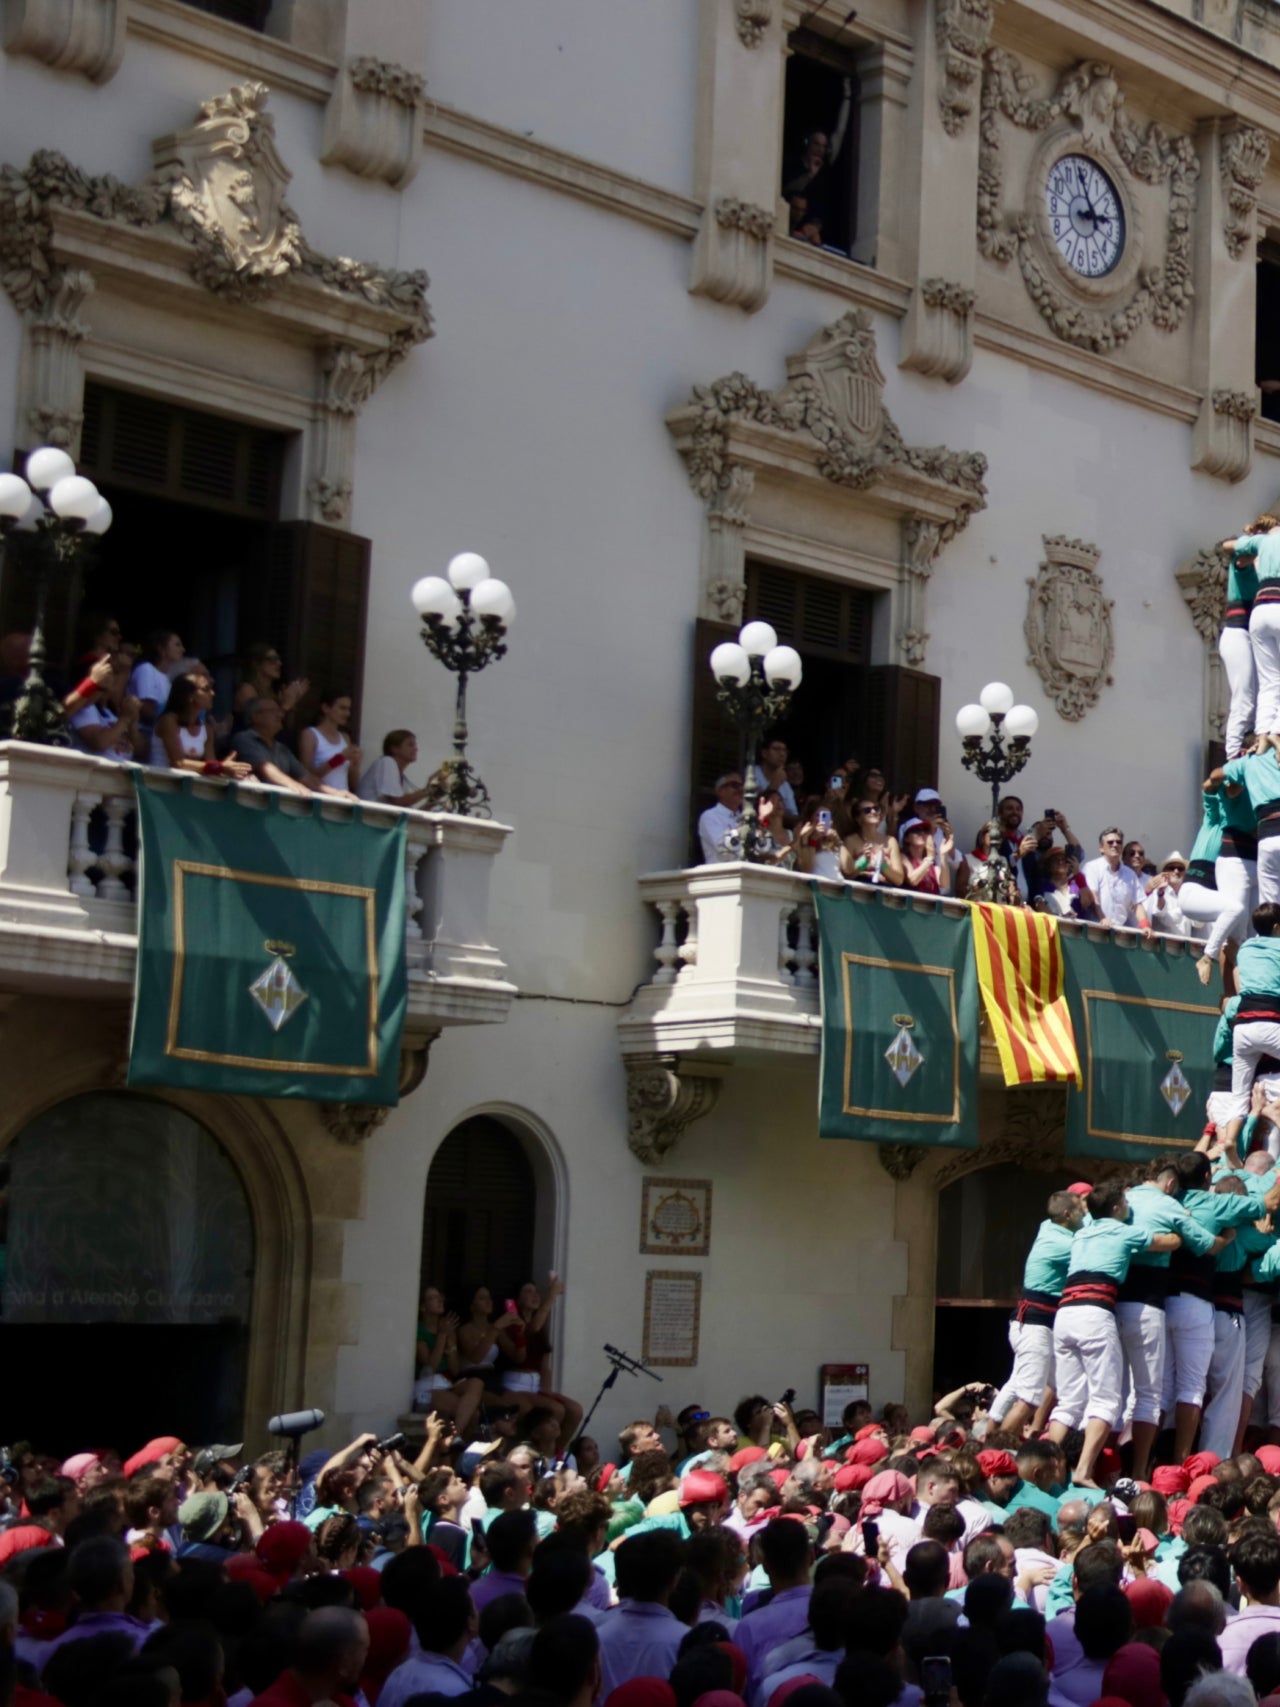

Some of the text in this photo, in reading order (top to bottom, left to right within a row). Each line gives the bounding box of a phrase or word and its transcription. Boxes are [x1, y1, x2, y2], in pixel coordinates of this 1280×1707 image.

[1054, 177, 1064, 195] 10
[1051, 196, 1058, 213] 9
[1104, 198, 1110, 215] 2
[1054, 218, 1060, 236] 8
[1065, 240, 1072, 256] 7
[1102, 240, 1107, 256] 4
[1077, 250, 1084, 267] 6
[1091, 251, 1098, 268] 5
